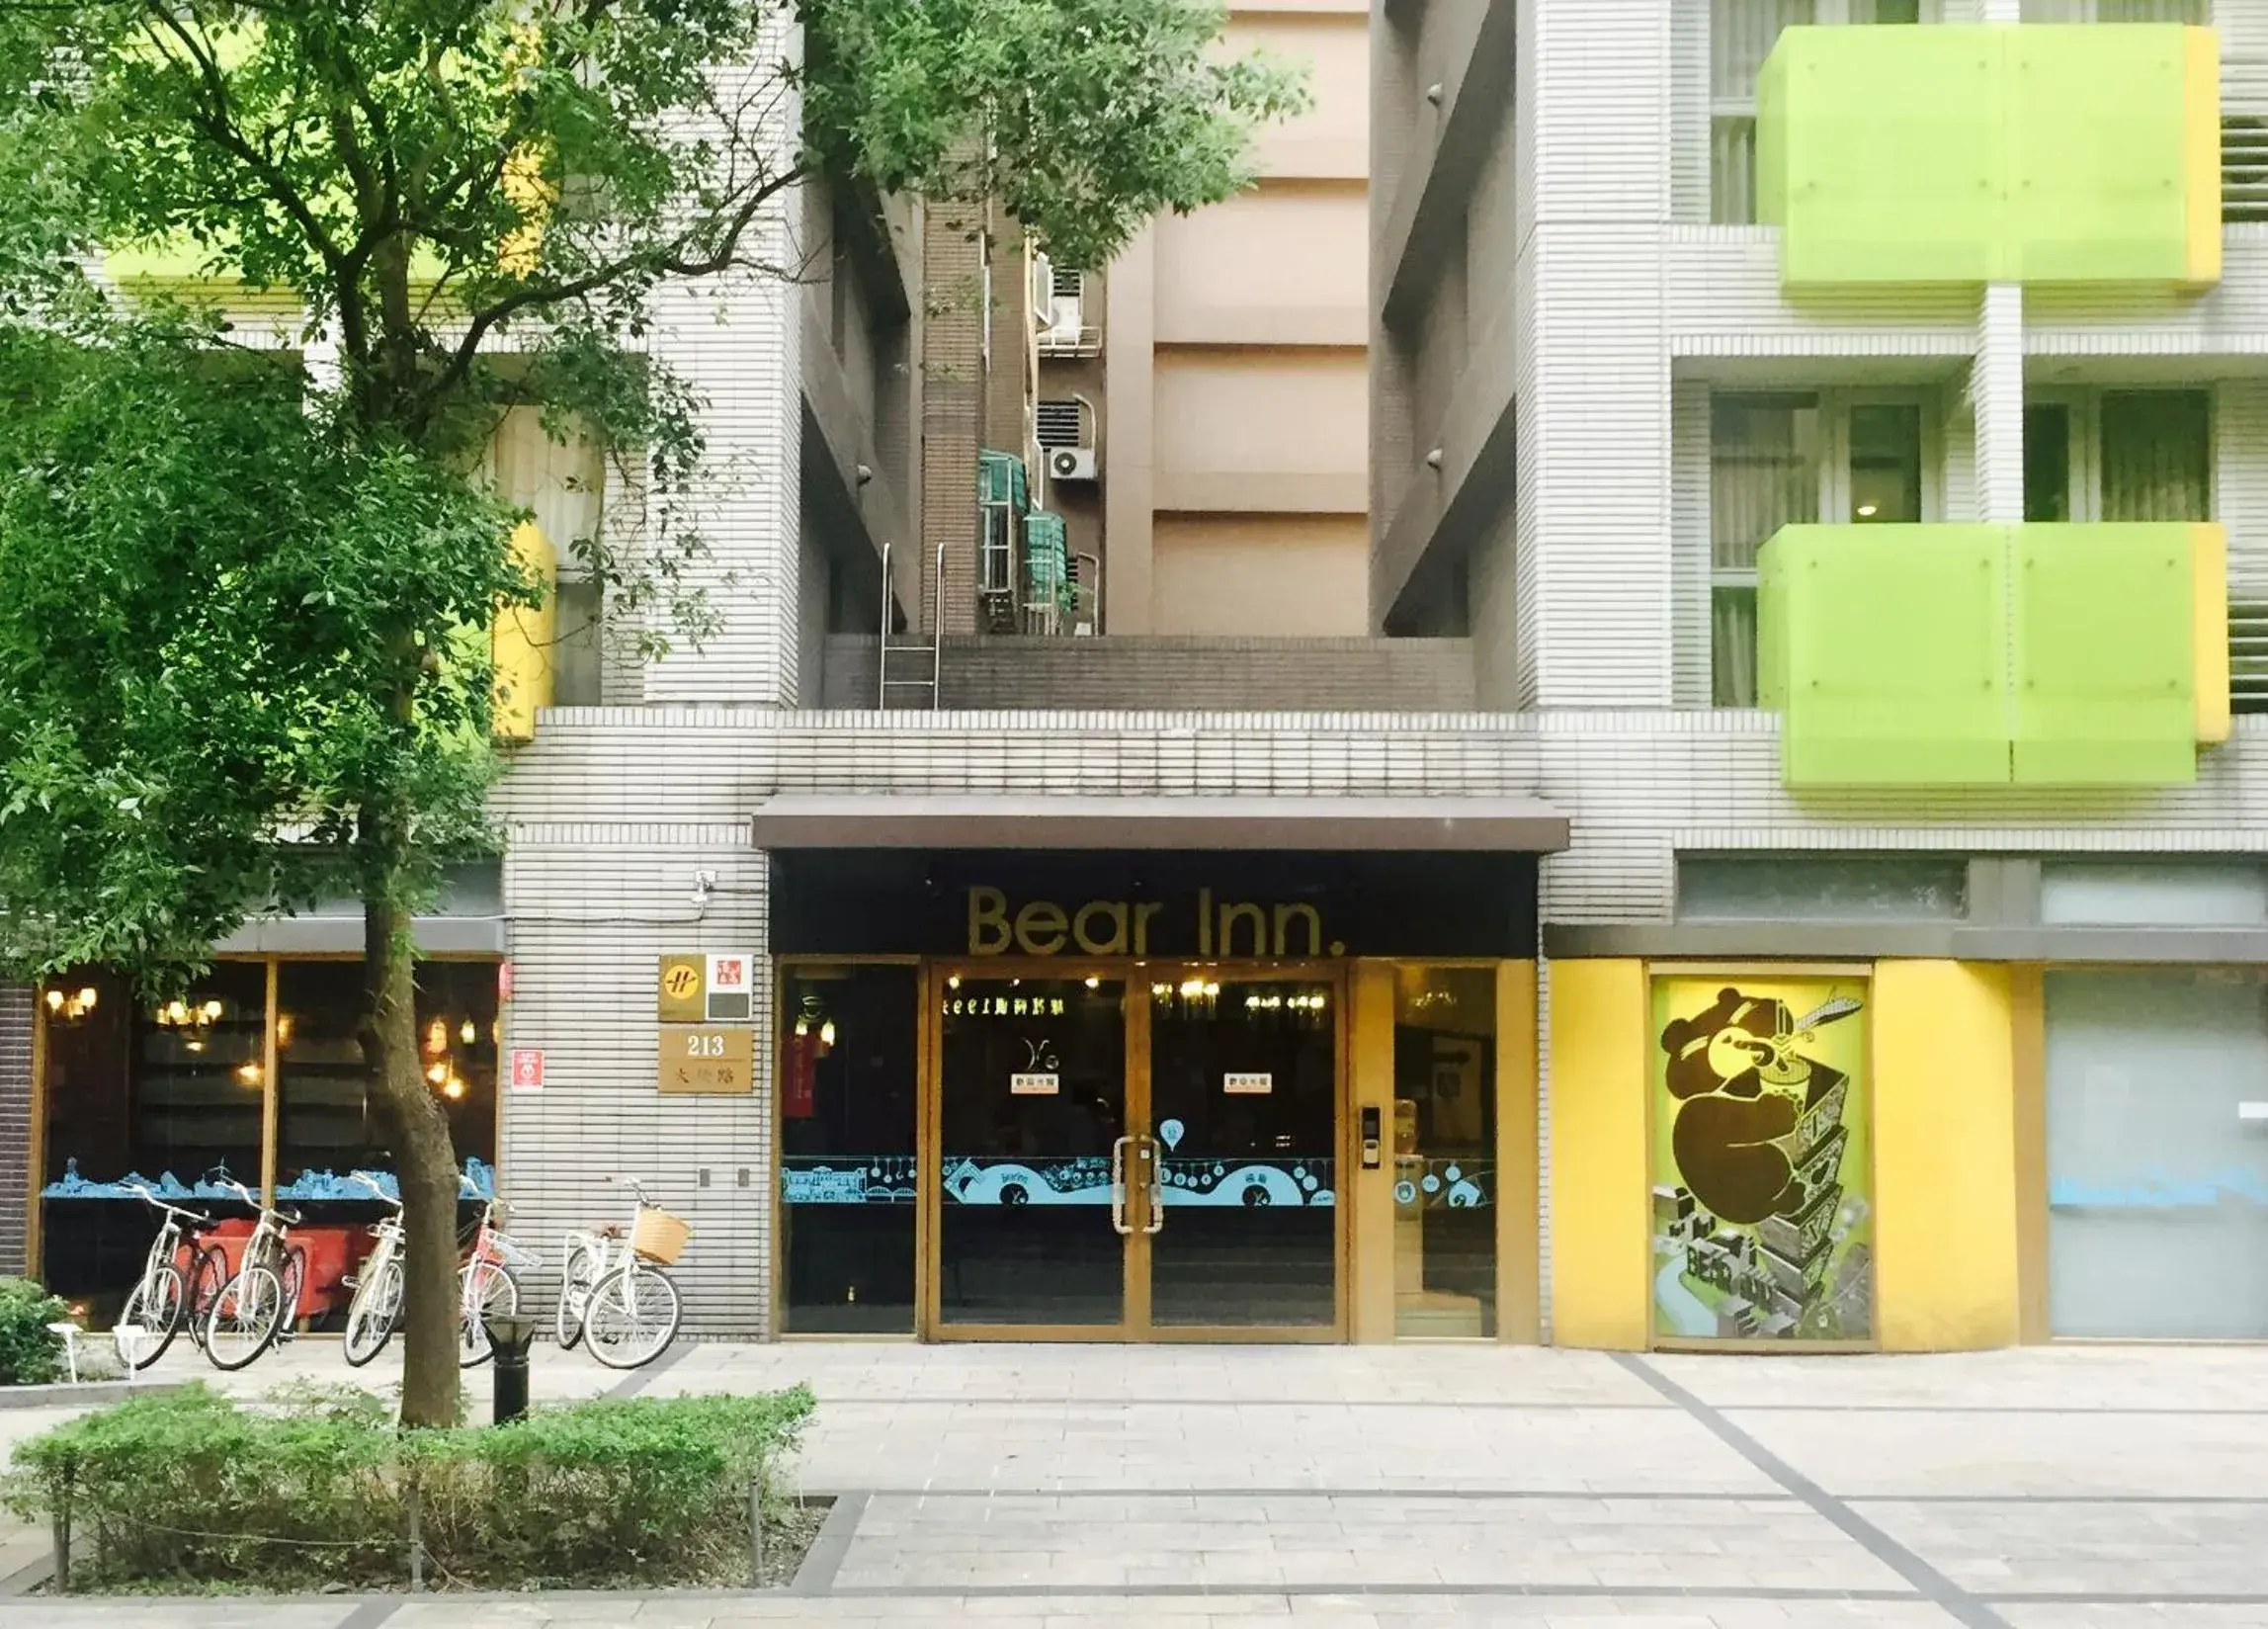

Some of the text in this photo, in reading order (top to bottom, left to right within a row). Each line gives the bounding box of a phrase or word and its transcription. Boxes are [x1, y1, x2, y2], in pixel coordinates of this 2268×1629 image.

[967, 885, 1346, 957] Bear Inn.
[687, 1035, 724, 1057] 213
